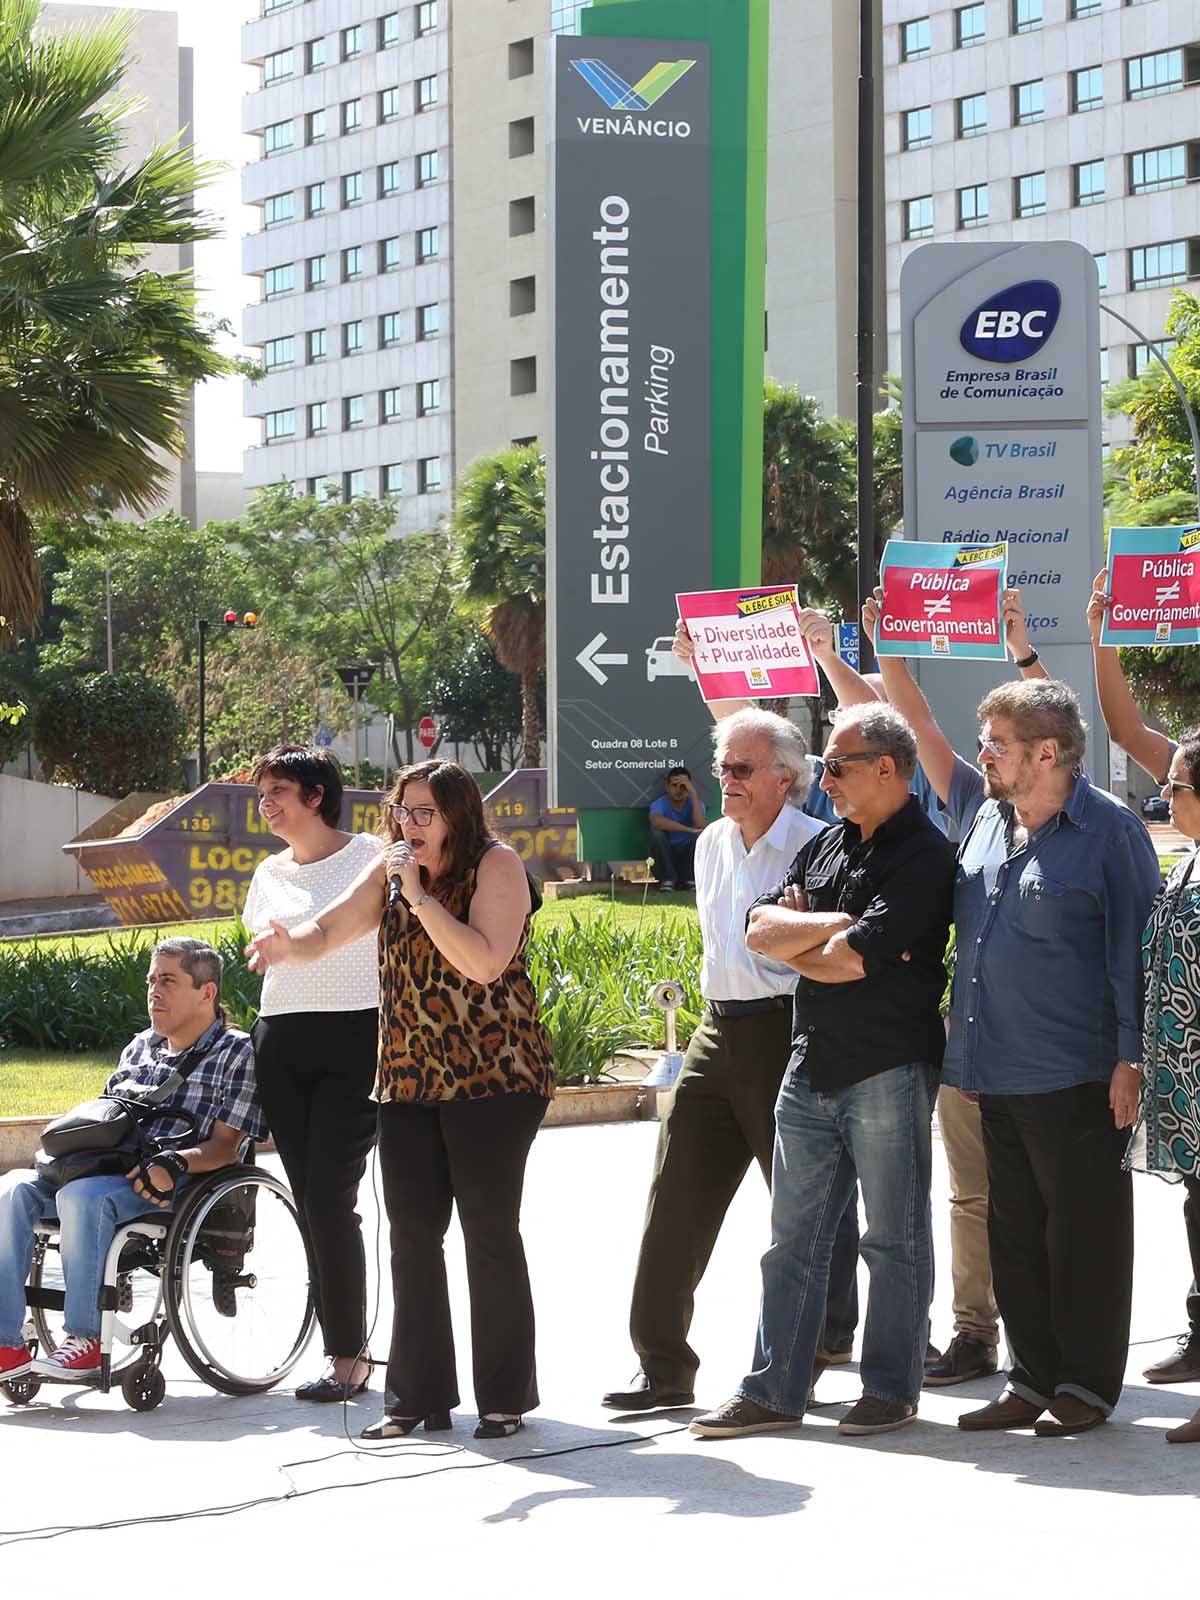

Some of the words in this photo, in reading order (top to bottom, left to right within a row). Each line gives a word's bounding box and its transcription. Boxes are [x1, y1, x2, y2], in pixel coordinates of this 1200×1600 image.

[577, 115, 691, 138] VENÂNCIO
[974, 310, 1047, 338] EBC
[946, 370, 1010, 384] Empresa
[1015, 368, 1058, 381] Brasil
[591, 195, 630, 603] Estacionamento
[644, 344, 675, 455] Parking
[940, 387, 959, 399] de
[963, 385, 1064, 399] Comunicação
[985, 444, 1007, 458] TV
[1010, 442, 1057, 458] Brasil
[944, 486, 1013, 503] Agência
[1018, 484, 1065, 499] Brasil
[942, 530, 990, 543] Rádio
[995, 528, 1069, 543] Nacional
[1142, 559, 1194, 579] Pública
[910, 573, 970, 591] Pública
[1006, 570, 1062, 588] gência
[752, 600, 767, 611] EBC
[774, 591, 794, 605] SUA!
[704, 621, 797, 643] Diversidade
[882, 614, 996, 635] Governamental
[1024, 614, 1059, 631] iços
[712, 641, 801, 664] Pluralidade
[591, 739, 628, 749] Quadra
[630, 739, 643, 749] 08
[645, 739, 667, 749] Lote
[670, 739, 678, 748] B
[585, 759, 612, 769] Setor
[614, 759, 666, 769] Comercial
[668, 759, 684, 768] Sul
